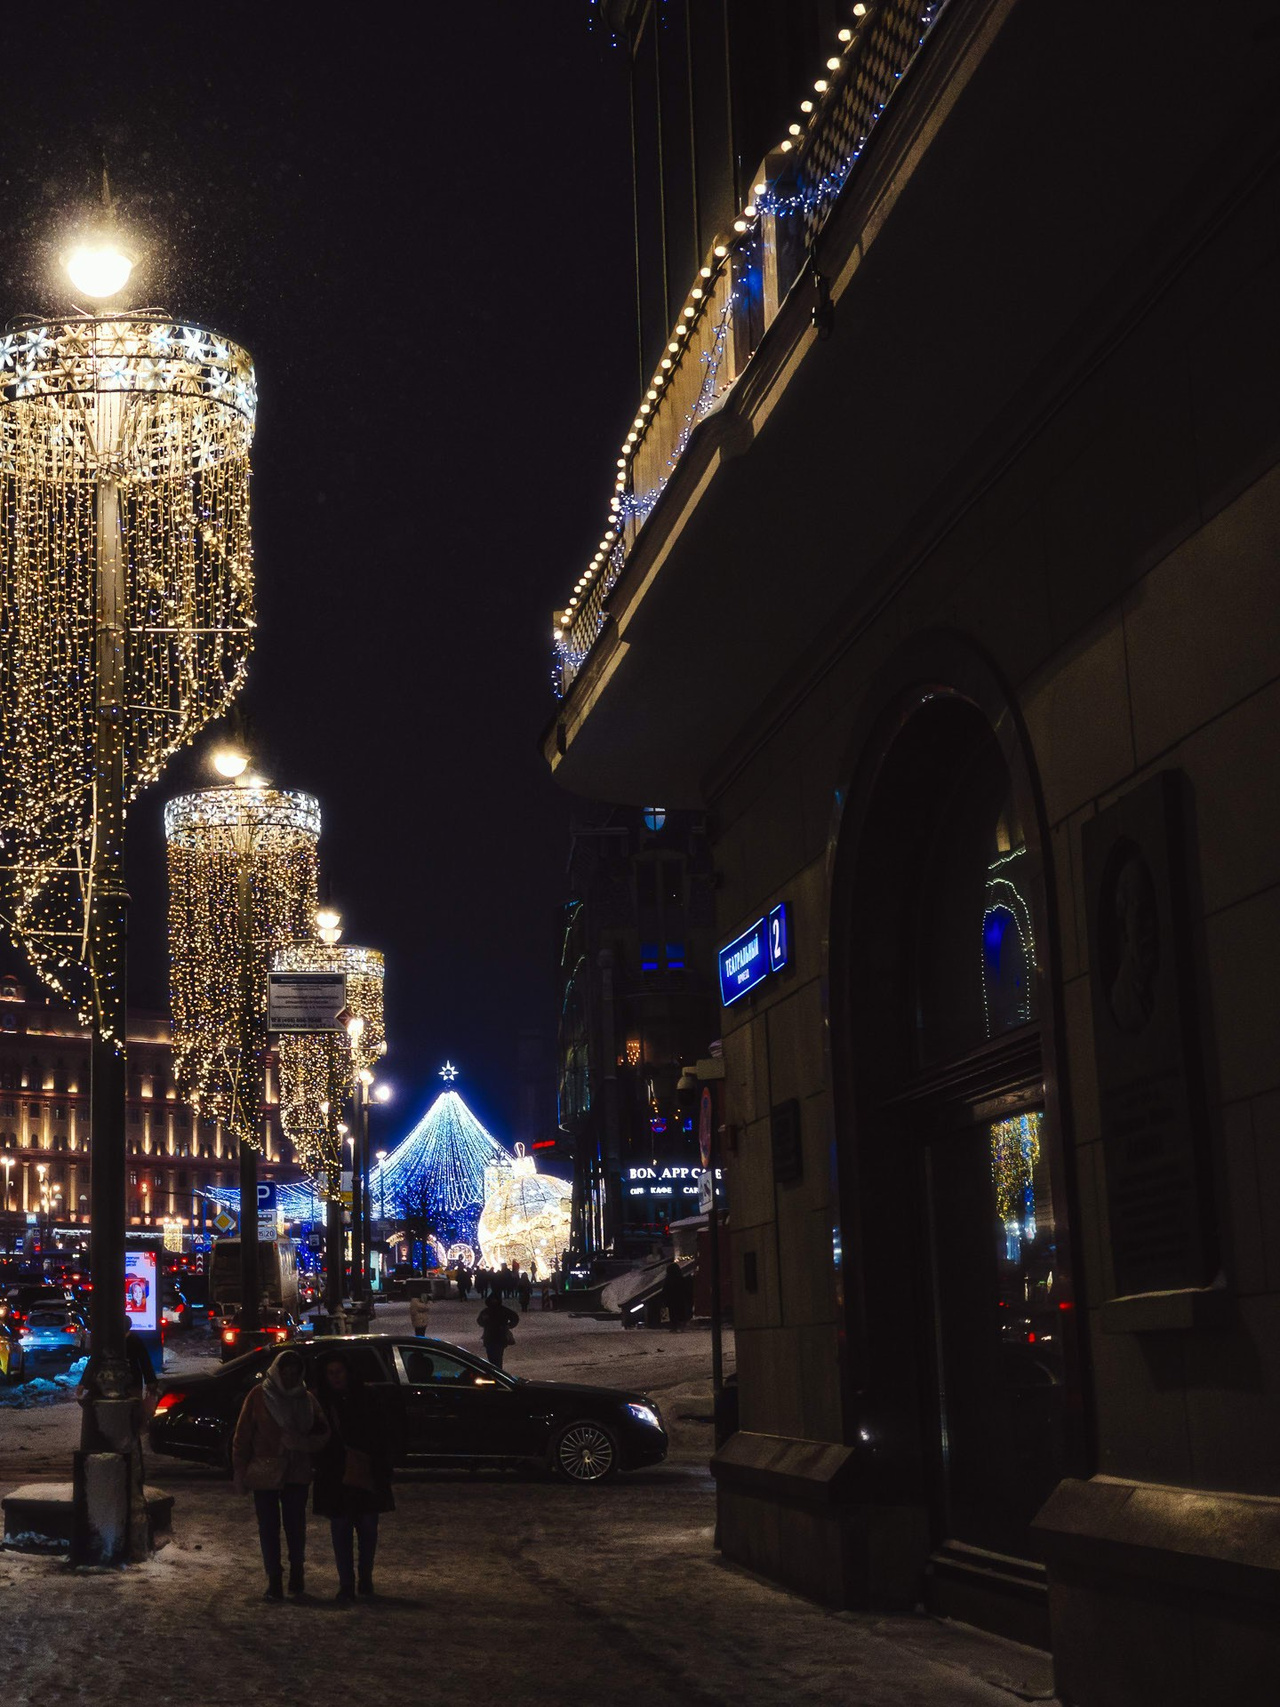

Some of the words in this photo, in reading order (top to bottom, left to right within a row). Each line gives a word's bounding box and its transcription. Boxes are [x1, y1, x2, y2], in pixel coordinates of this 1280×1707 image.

[772, 919, 782, 959] 2
[725, 933, 760, 978] ТЕАТРАЛЬНЫЙ
[661, 1168, 689, 1179] APP
[257, 1185, 270, 1206] P
